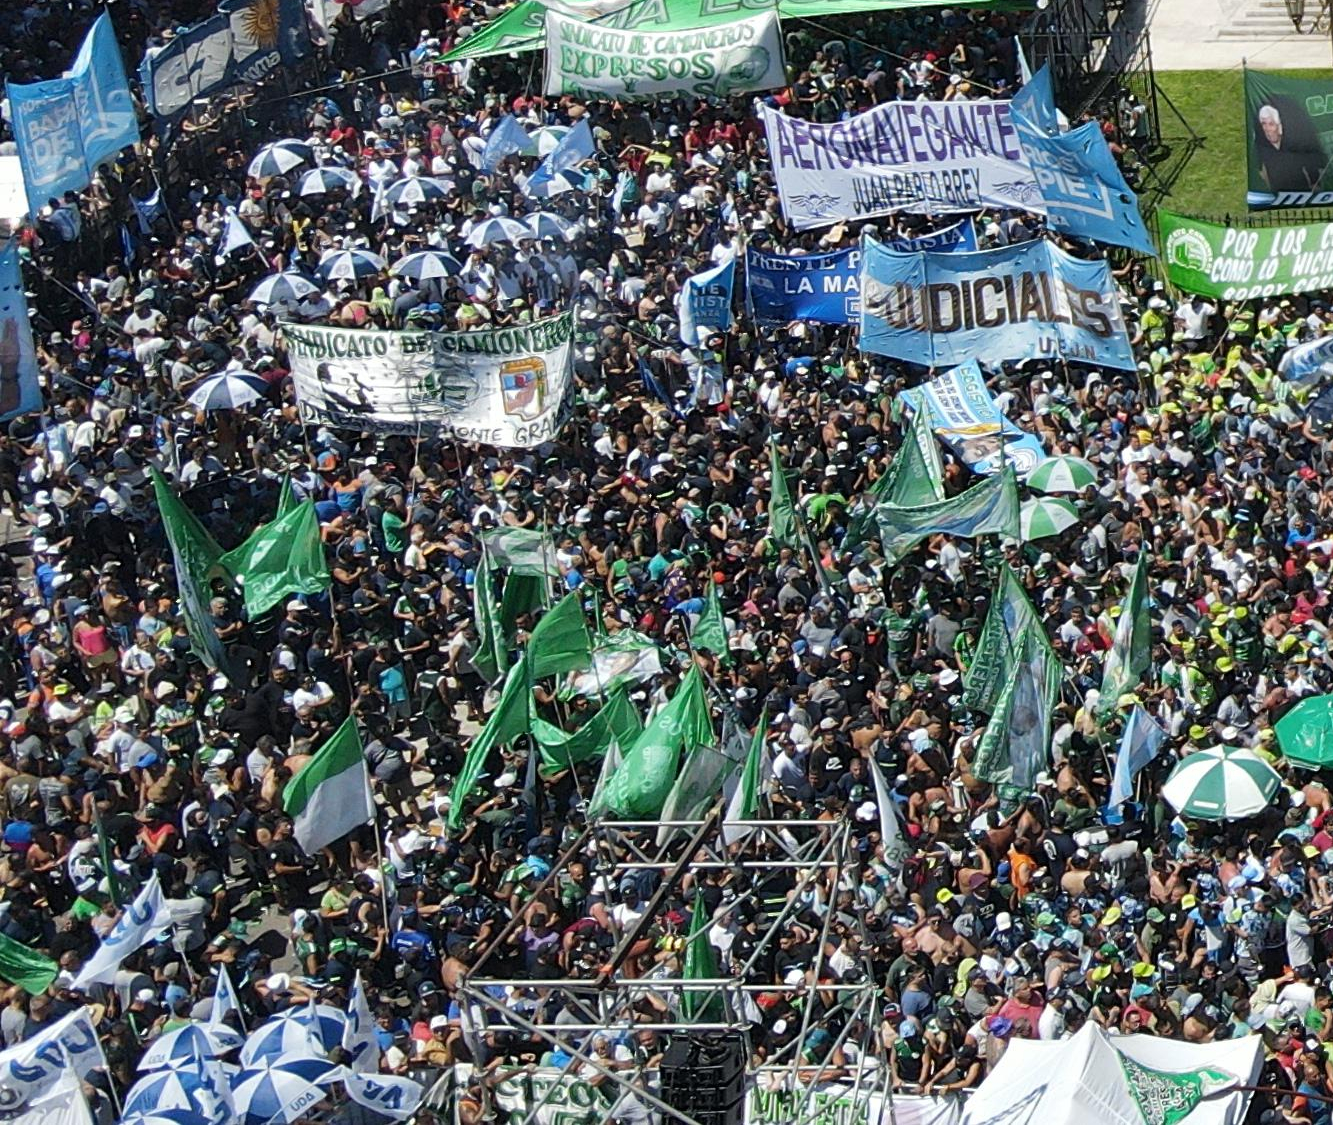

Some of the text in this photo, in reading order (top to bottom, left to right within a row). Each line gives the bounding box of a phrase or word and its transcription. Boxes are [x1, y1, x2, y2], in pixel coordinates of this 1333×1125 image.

[559, 20, 755, 55] SINDICATO DE CAMIONEROS
[560, 45, 716, 81] EXPRESOS
[775, 103, 1020, 172] AERONAVEGANTE
[853, 178, 892, 215] JUAN
[942, 167, 981, 204] BREY
[1221, 227, 1259, 257] POR
[1270, 229, 1307, 257] LOS
[784, 277, 811, 294] LA
[1210, 257, 1252, 284] COMO
[1256, 258, 1279, 280] LO
